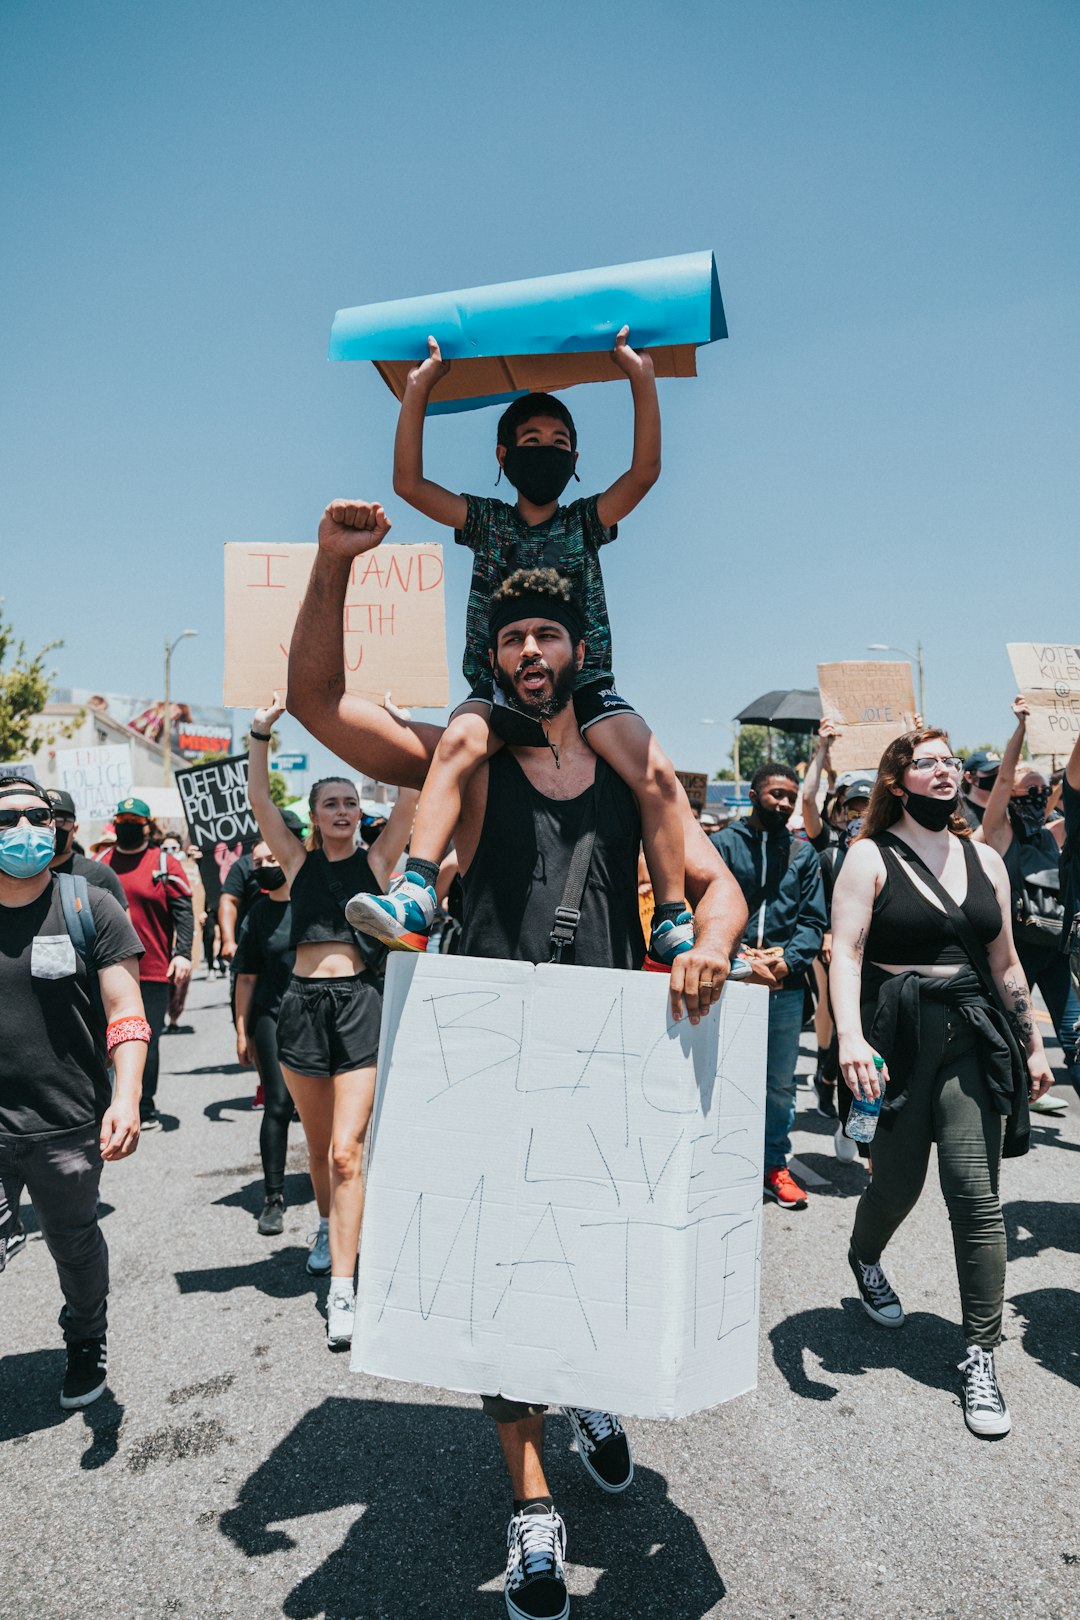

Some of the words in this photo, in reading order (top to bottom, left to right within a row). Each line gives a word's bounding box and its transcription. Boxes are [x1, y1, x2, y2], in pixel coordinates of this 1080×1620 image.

[247, 553, 289, 588] I
[351, 553, 444, 592] TAND
[1033, 645, 1076, 666] VOTE
[1055, 681, 1070, 698] @
[857, 708, 895, 722] VOTE
[1048, 699, 1080, 714] THE
[178, 734, 231, 752] MISSY
[194, 813, 259, 847] NOW
[423, 986, 764, 1148] BLACK
[525, 1124, 759, 1214] LIVES
